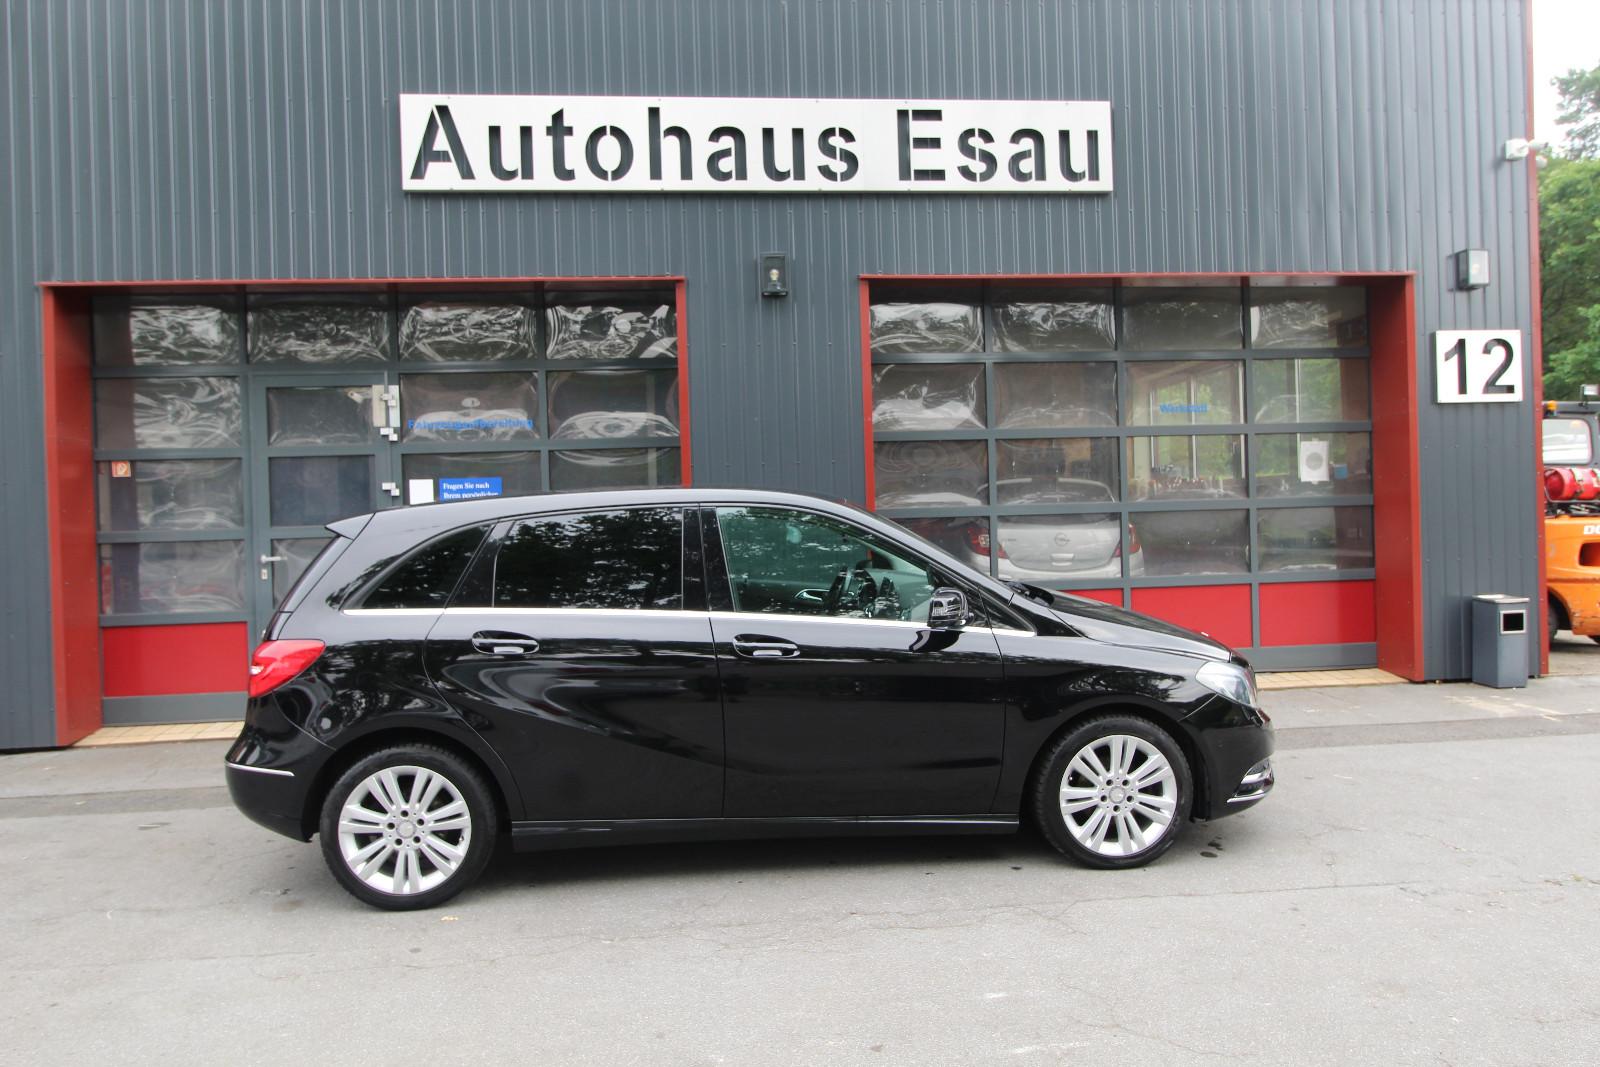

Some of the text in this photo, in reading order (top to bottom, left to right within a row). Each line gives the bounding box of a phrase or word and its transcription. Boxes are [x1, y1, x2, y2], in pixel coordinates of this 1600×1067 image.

[410, 104, 1101, 183] Autohaus Esau
[1444, 338, 1515, 395] 12
[443, 482, 464, 490] Fragen
